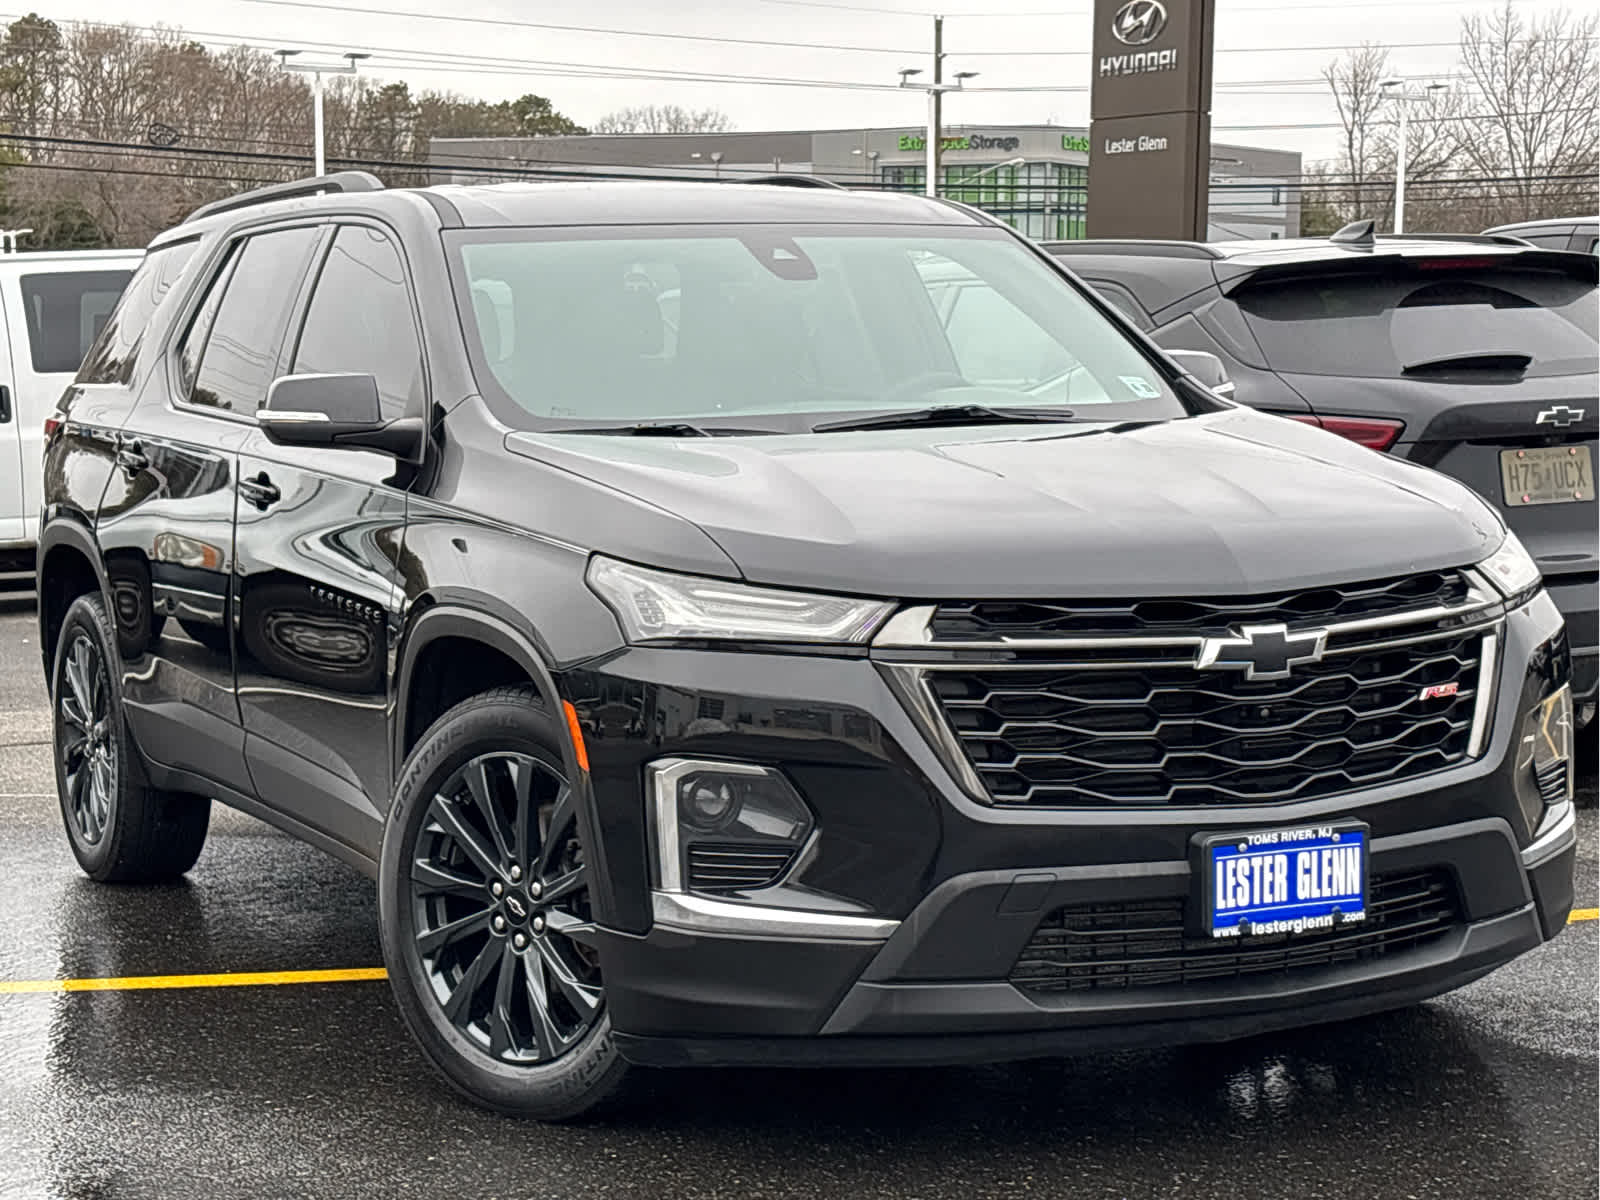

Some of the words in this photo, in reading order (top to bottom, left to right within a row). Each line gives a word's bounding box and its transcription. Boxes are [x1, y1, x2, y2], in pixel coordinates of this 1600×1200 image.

[1100, 49, 1177, 76] HYUNDAI
[1105, 138, 1136, 154] Lester
[1138, 136, 1168, 151] Glenn
[1248, 833, 1278, 846] TOMS
[1318, 827, 1333, 839] NJ
[1216, 854, 1288, 910] LESTER
[1296, 847, 1361, 901] GLENN
[1251, 915, 1333, 935] lesterglenn
